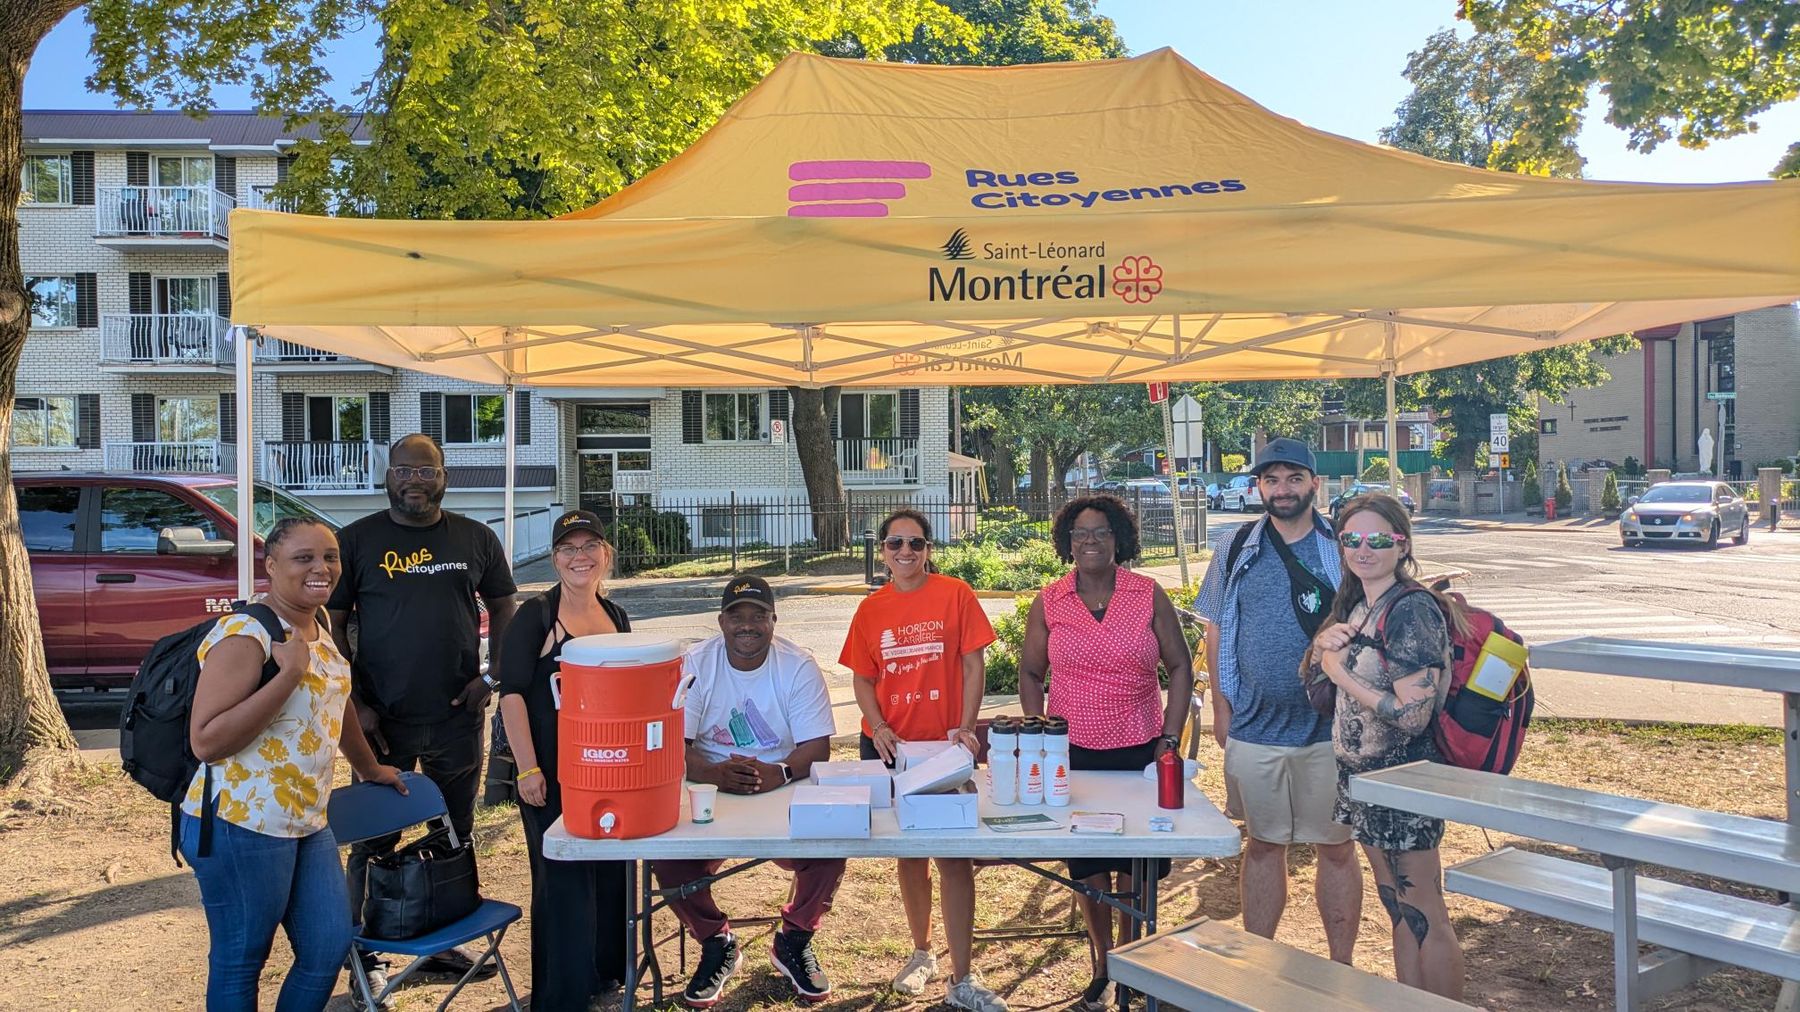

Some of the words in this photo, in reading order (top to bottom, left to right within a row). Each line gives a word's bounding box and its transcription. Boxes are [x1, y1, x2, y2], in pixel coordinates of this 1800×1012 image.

[965, 169, 1080, 188] Rues
[970, 179, 1247, 209] Citoyennes
[983, 241, 1105, 261] Saint-Léonard
[928, 264, 1106, 302] Montréal
[1493, 435, 1507, 447] 40
[379, 547, 433, 579] Rues
[406, 562, 468, 575] citoyennes
[897, 620, 944, 636] HORIZON
[583, 748, 627, 759] IGLOO
